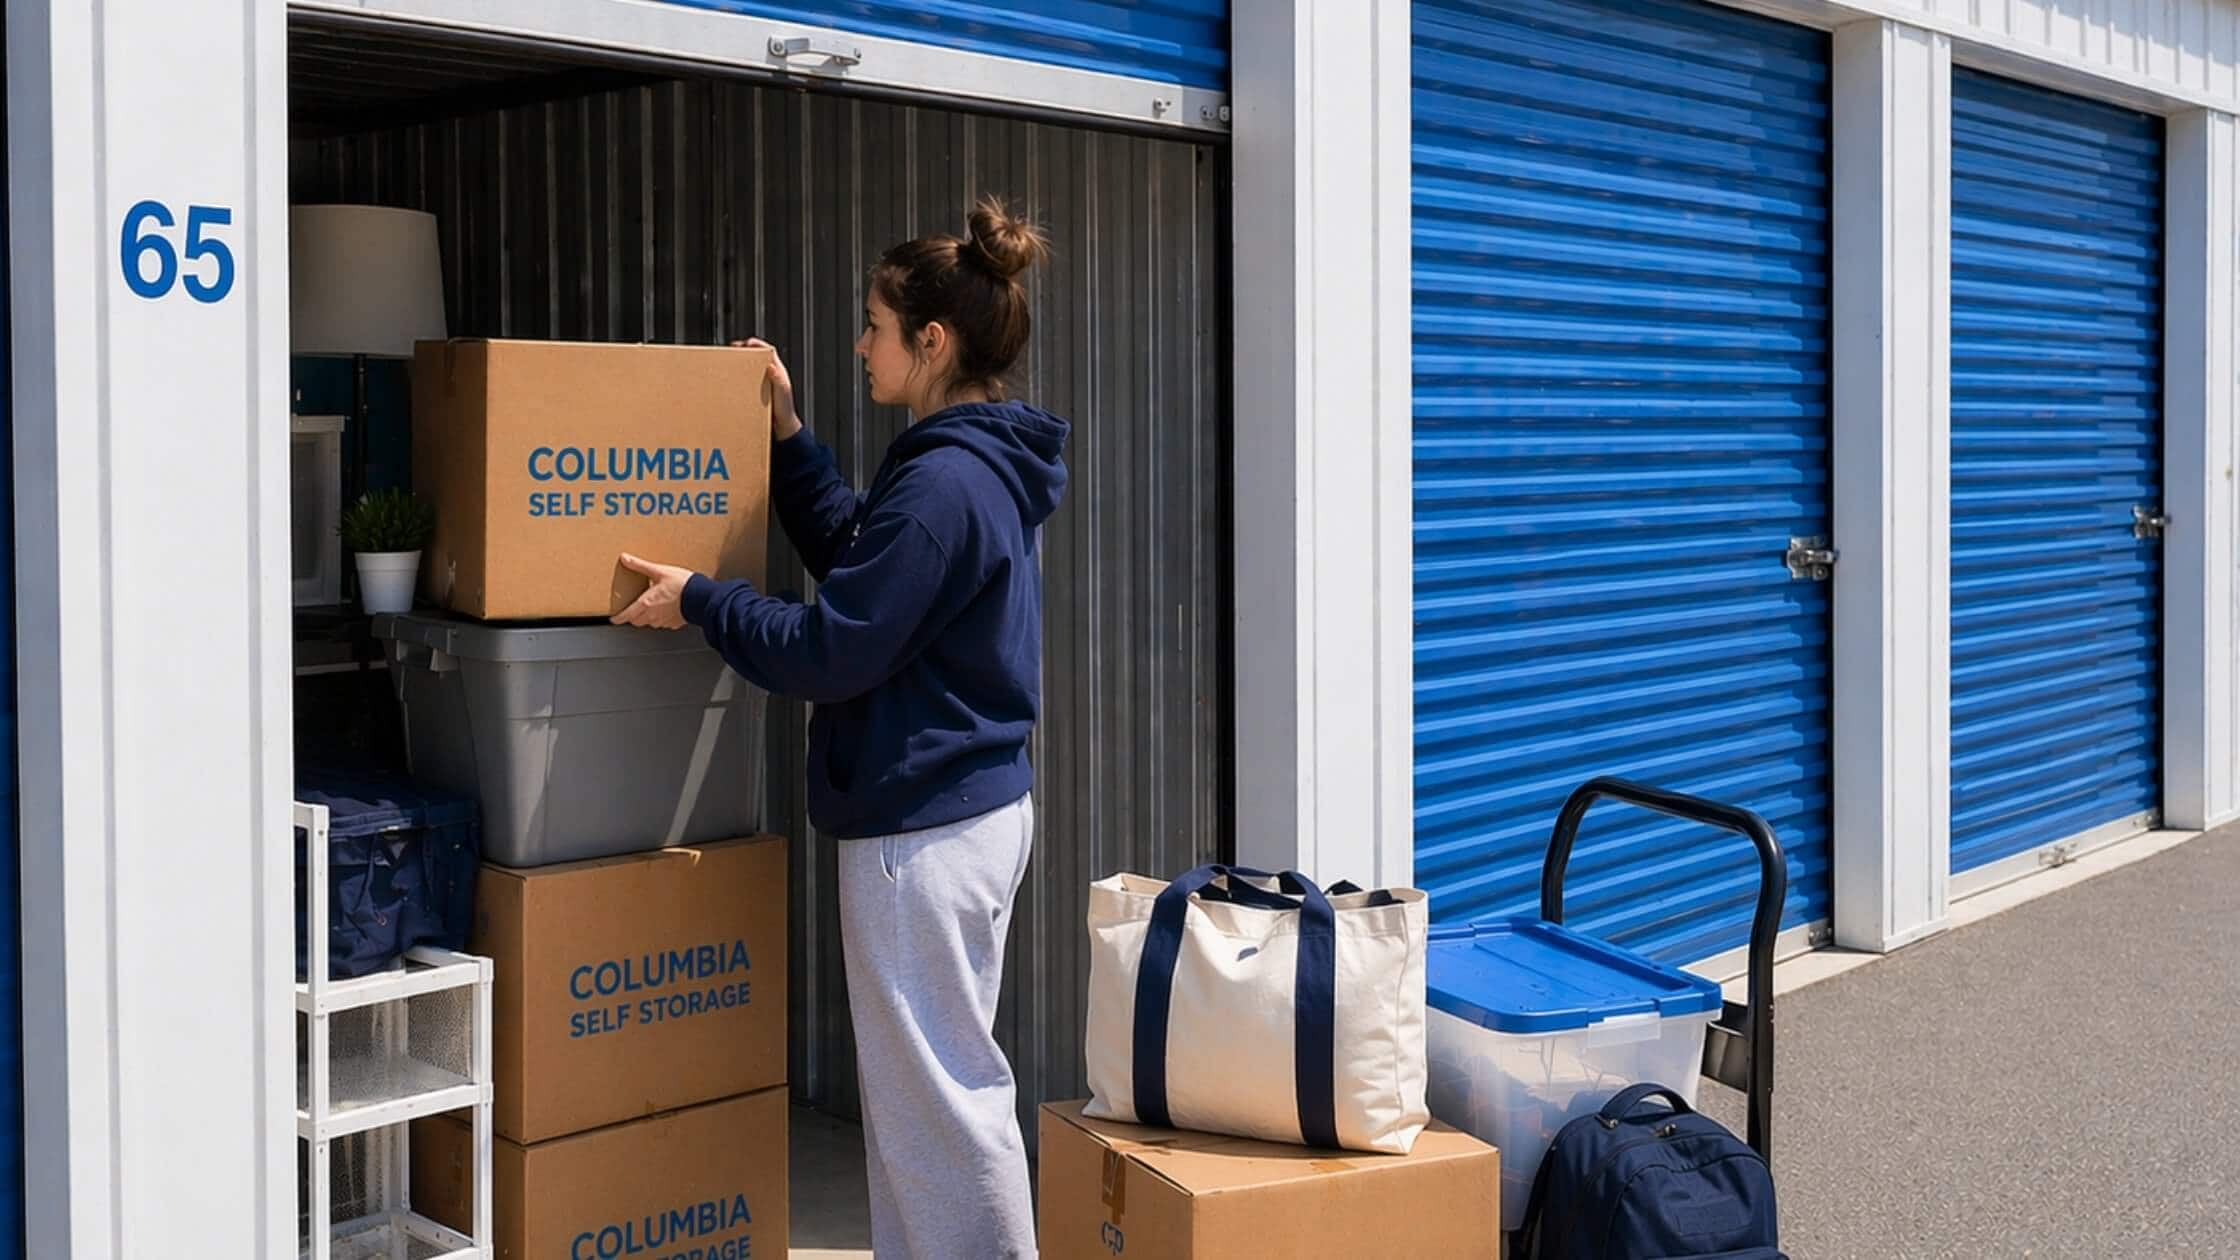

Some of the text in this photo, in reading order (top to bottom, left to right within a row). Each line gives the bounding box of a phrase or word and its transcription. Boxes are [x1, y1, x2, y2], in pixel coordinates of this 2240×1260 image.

[121, 200, 235, 304] 65
[528, 447, 729, 481] COLUMBIA
[529, 491, 728, 517] SELF STORAGE
[570, 940, 750, 1000] COLUMBIA
[570, 982, 750, 1038] SELF STORAGE
[571, 1193, 751, 1260] COLUMBIA
